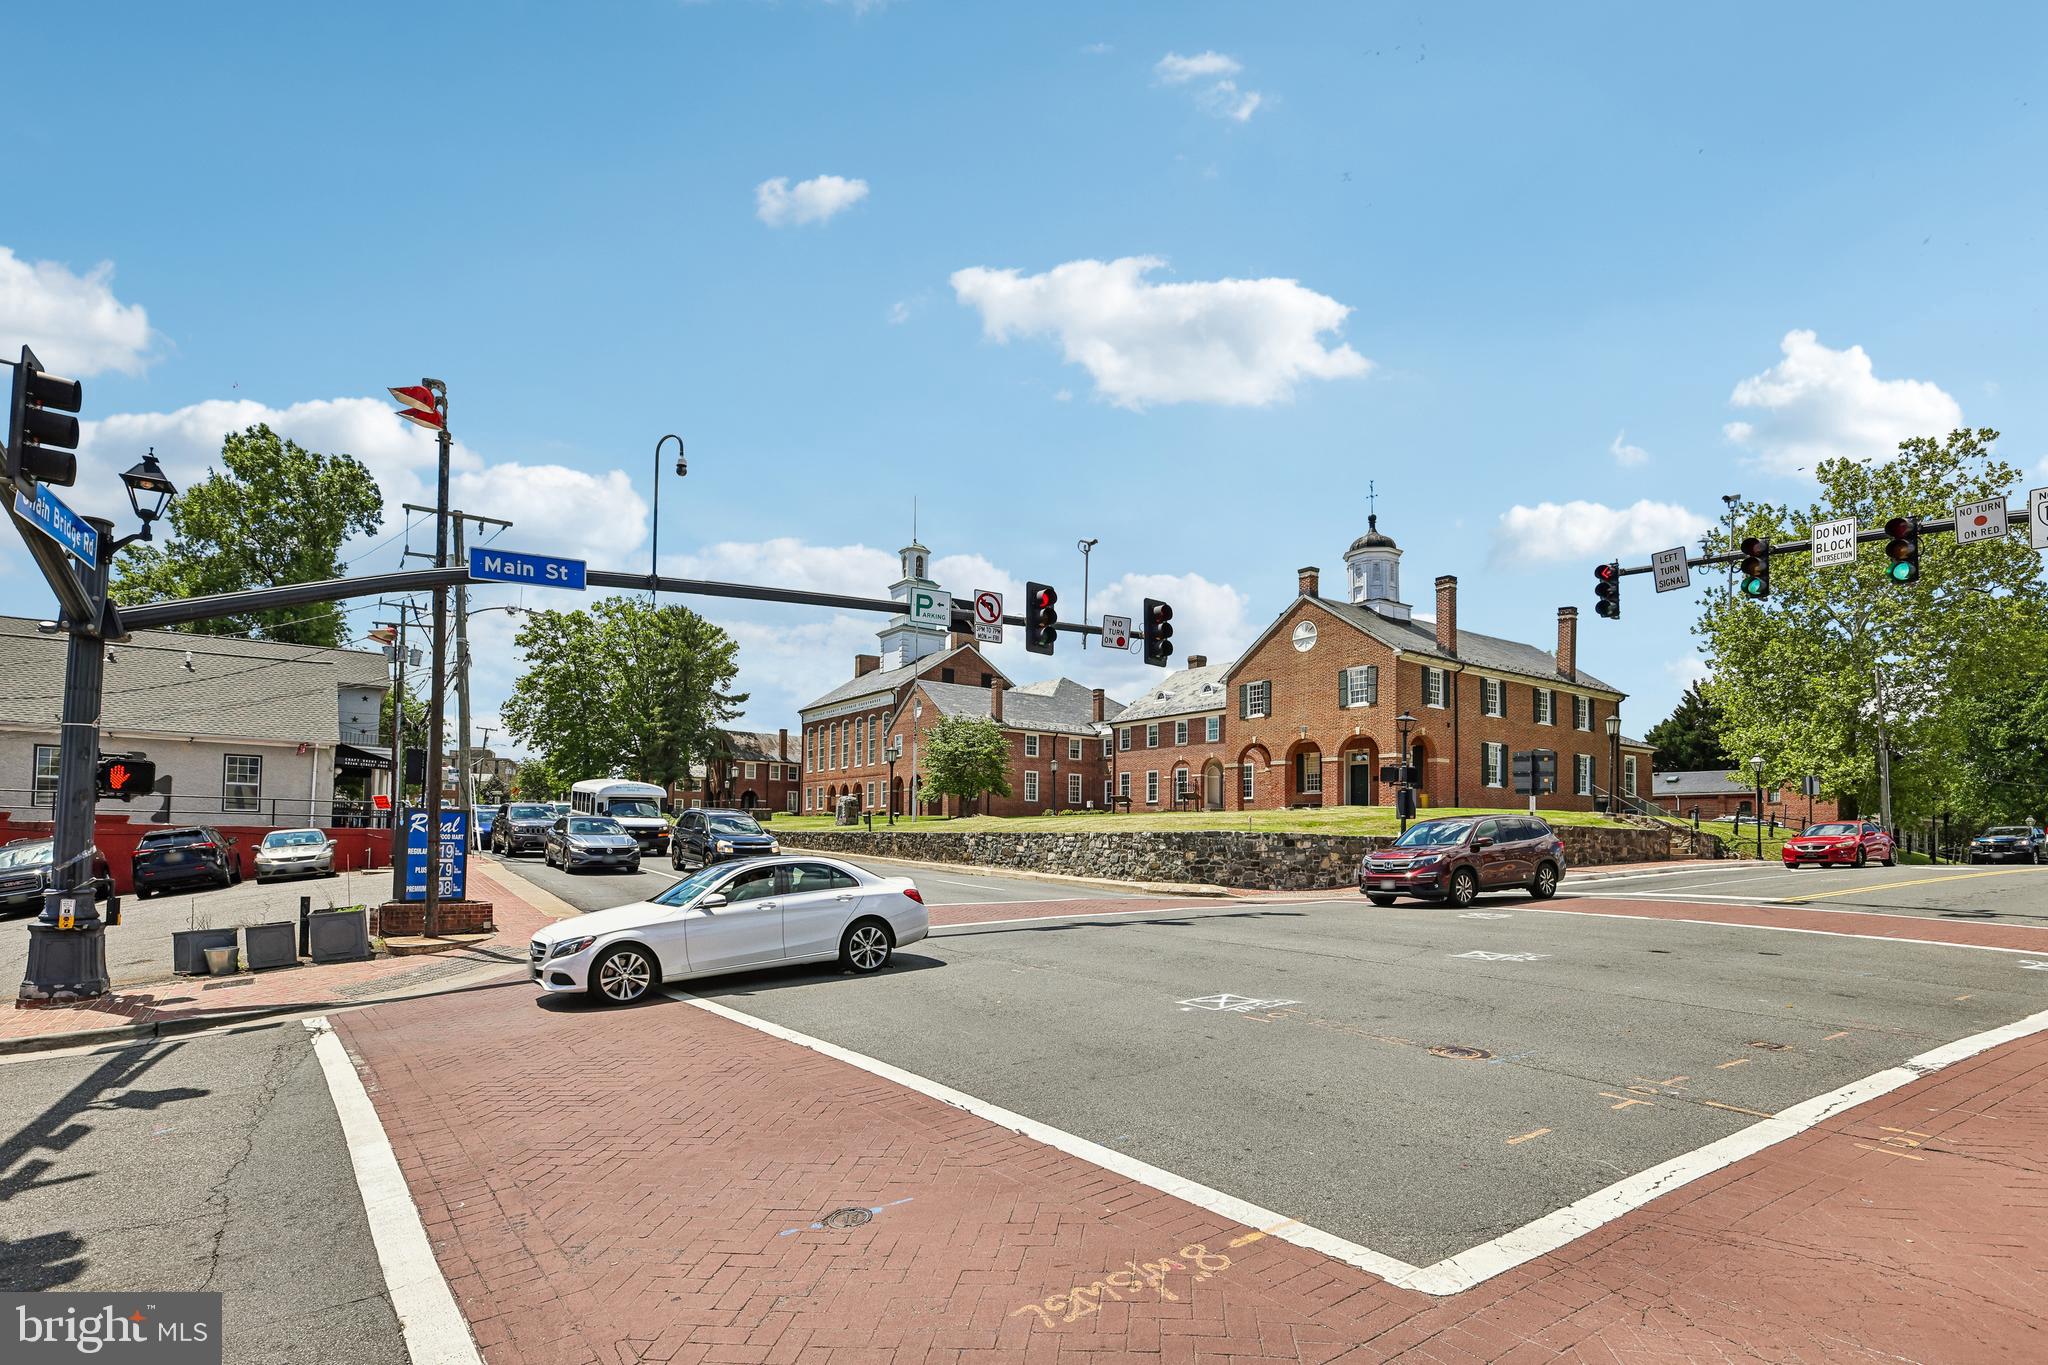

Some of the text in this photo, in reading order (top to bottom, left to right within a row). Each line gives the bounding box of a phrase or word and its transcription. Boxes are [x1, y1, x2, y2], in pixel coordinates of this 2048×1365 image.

[1959, 501, 2001, 517] NO TURN
[53, 506, 81, 549] Bridge
[83, 532, 94, 557] Rd
[1816, 523, 1853, 540] DO NOT
[1964, 526, 2000, 539] ON RED
[1816, 538, 1853, 554] BLOCK
[1659, 553, 1678, 564] LEFT
[1815, 551, 1853, 563] INTERSECTION
[484, 556, 568, 581] Main St
[1660, 566, 1680, 575] TURN
[1659, 577, 1686, 589] SIGNAL
[1111, 619, 1123, 628] NO
[1109, 628, 1125, 637] TURN
[410, 813, 461, 833] Ral
[415, 866, 427, 874] PLUS
